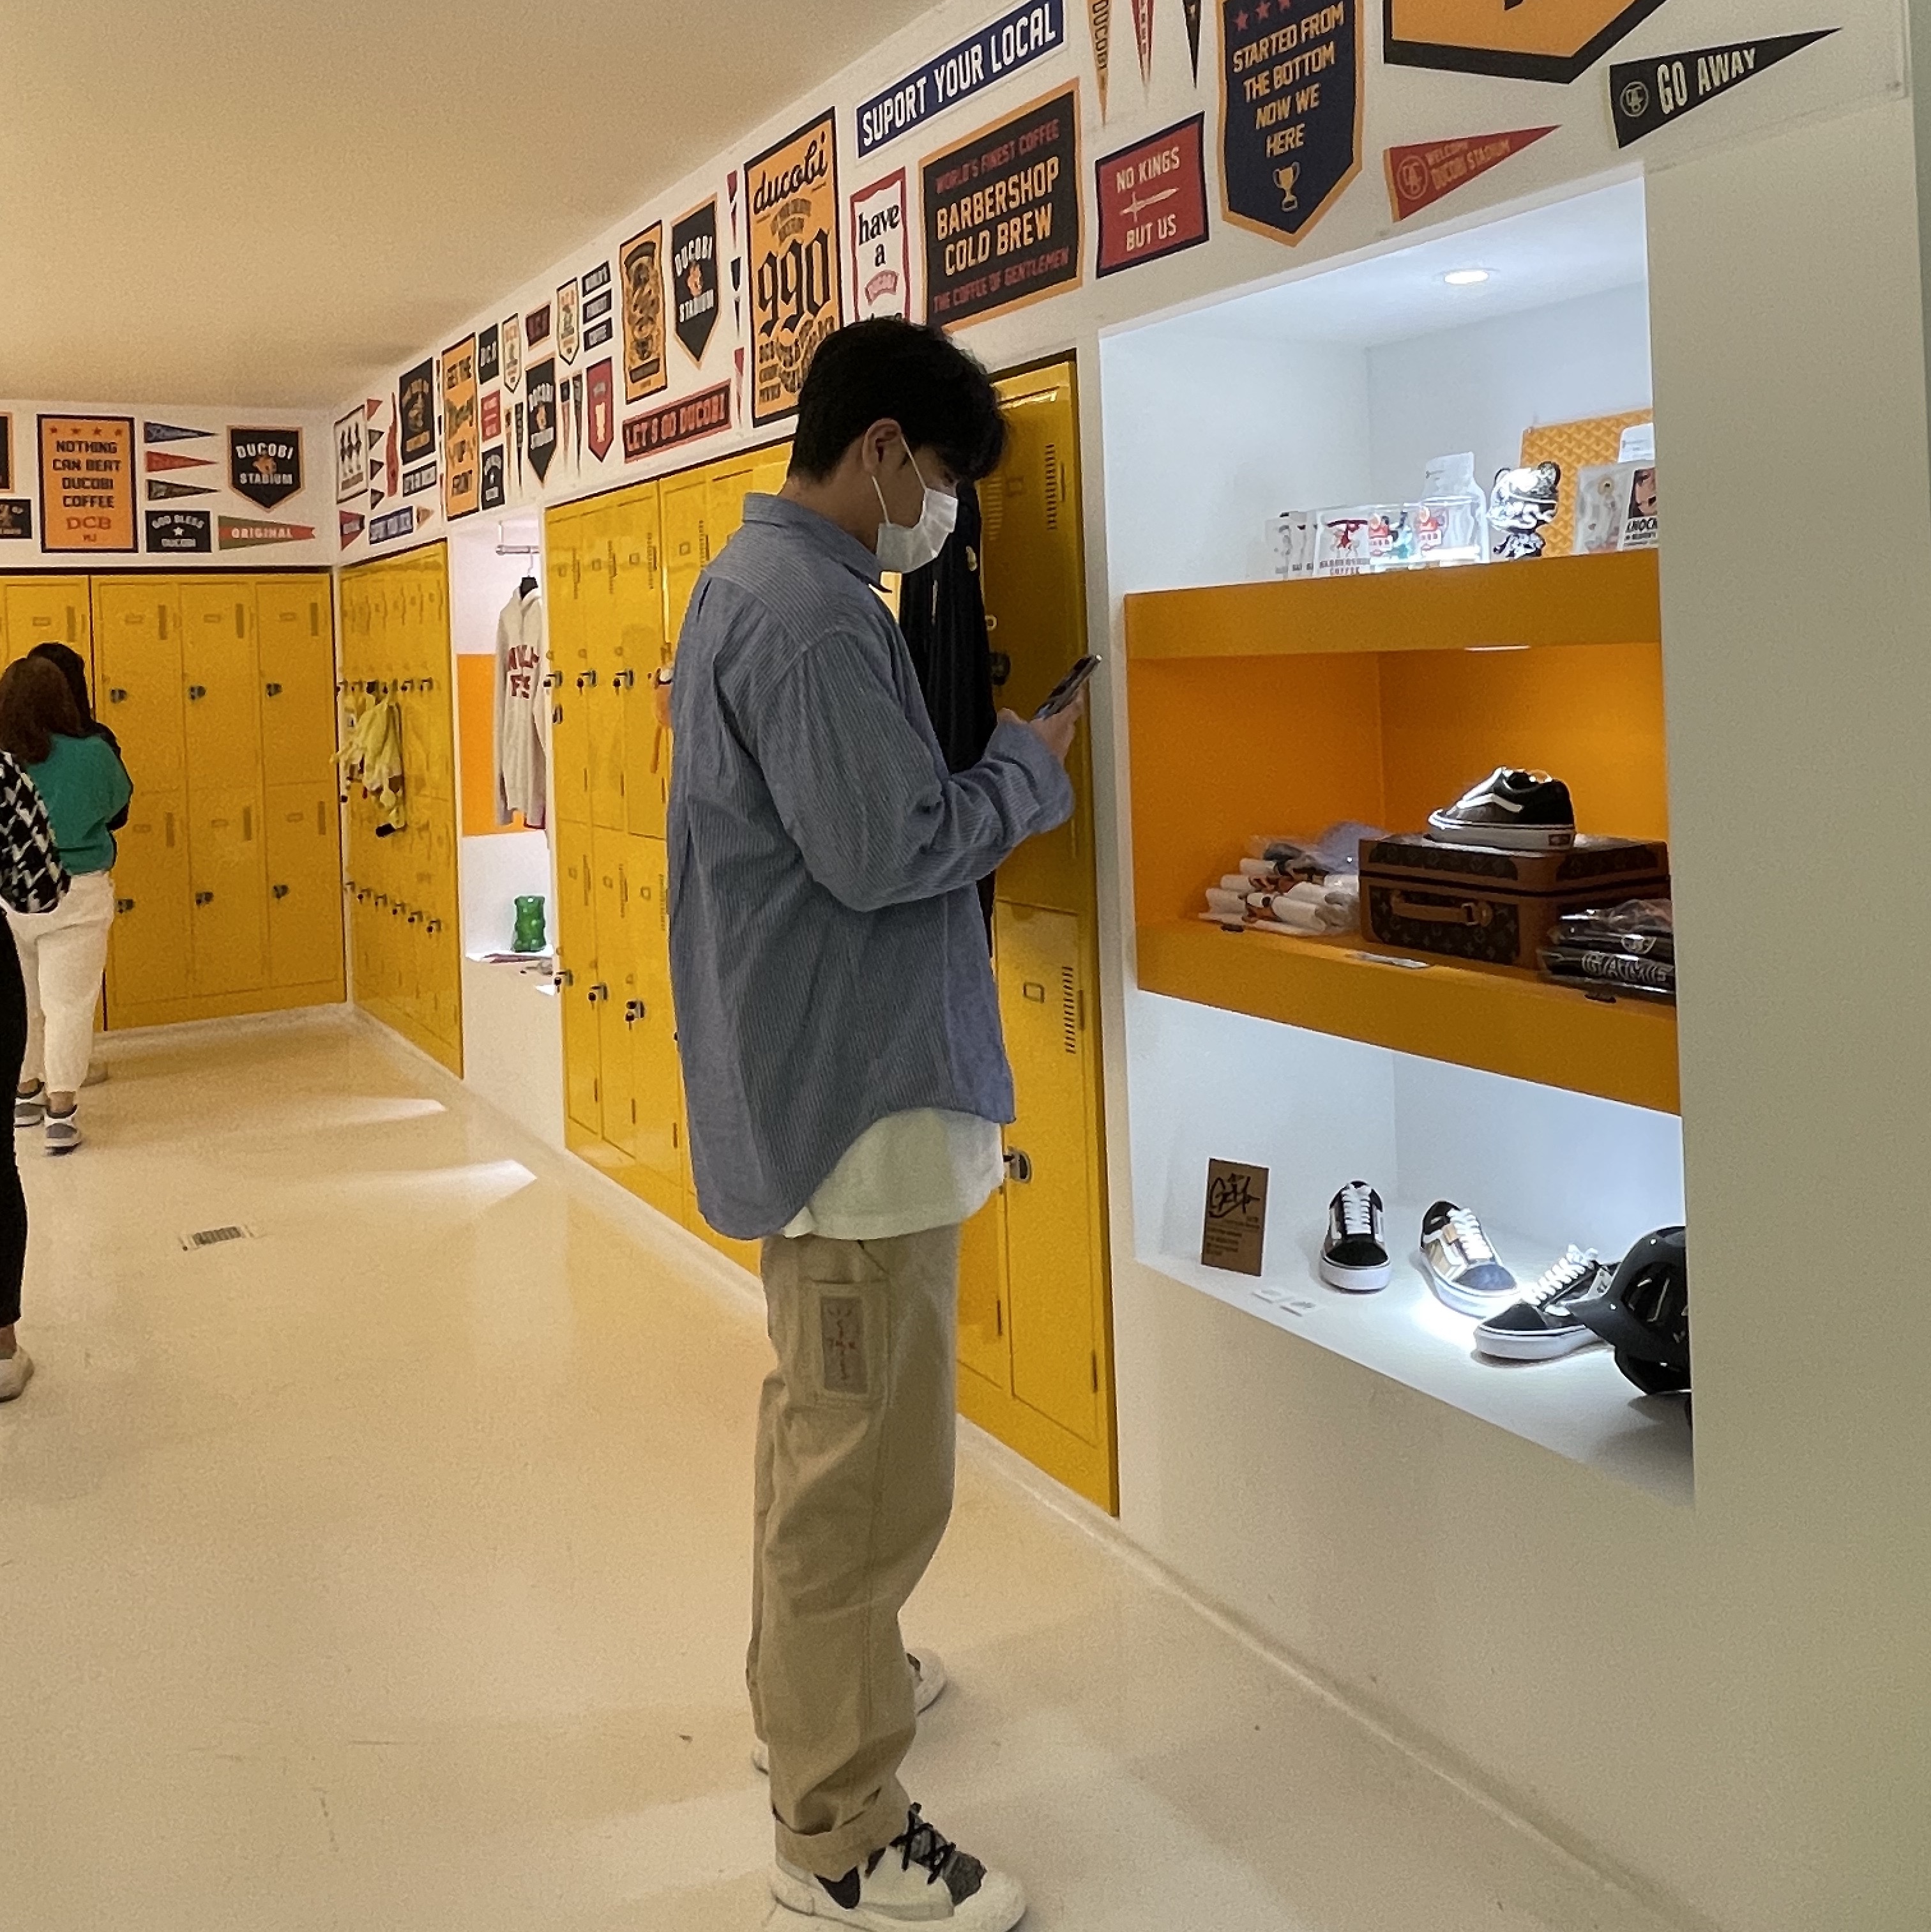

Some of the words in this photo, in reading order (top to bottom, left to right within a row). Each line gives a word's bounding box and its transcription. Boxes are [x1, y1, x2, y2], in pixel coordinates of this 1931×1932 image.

[1233, 24, 1297, 73] STARTED
[1301, 1, 1344, 43] FROM
[863, 77, 927, 146] SUPORT
[934, 43, 984, 103] YOUR
[991, 3, 1056, 73] LOCAL
[1243, 70, 1270, 102] THE
[1273, 41, 1335, 89] BOTTOM
[1657, 61, 1688, 114] GO
[1697, 47, 1755, 95] AWAY
[1256, 96, 1291, 130] NOW
[1296, 82, 1321, 114] WE
[981, 141, 1015, 174] FINEST
[1019, 119, 1059, 155] COFFEE
[1266, 123, 1305, 158] HERE
[753, 131, 828, 215] ducobi
[1117, 167, 1134, 193] NO
[1139, 146, 1179, 184] KINGS
[937, 156, 1059, 240] BARBERSHOP
[859, 204, 900, 245] have
[944, 230, 990, 276] COLD
[997, 202, 1052, 255] BREW
[1126, 222, 1153, 252] BUT
[1158, 214, 1176, 239] US
[675, 235, 713, 277] DUCOBI
[875, 244, 886, 267] a
[934, 292, 950, 313] THE
[953, 277, 987, 305] COFFEE
[1004, 247, 1069, 285] GENTLEMEN
[52, 459, 81, 471] CAN
[86, 459, 121, 471] BEAT
[56, 440, 117, 453] NOTHING
[235, 443, 294, 459] DUCOBI
[62, 477, 114, 489] DUCOBI
[239, 472, 292, 485] STADIUM
[63, 495, 114, 508] COFFEE
[66, 516, 111, 530] DCB
[231, 527, 293, 538] ORIGINAL
